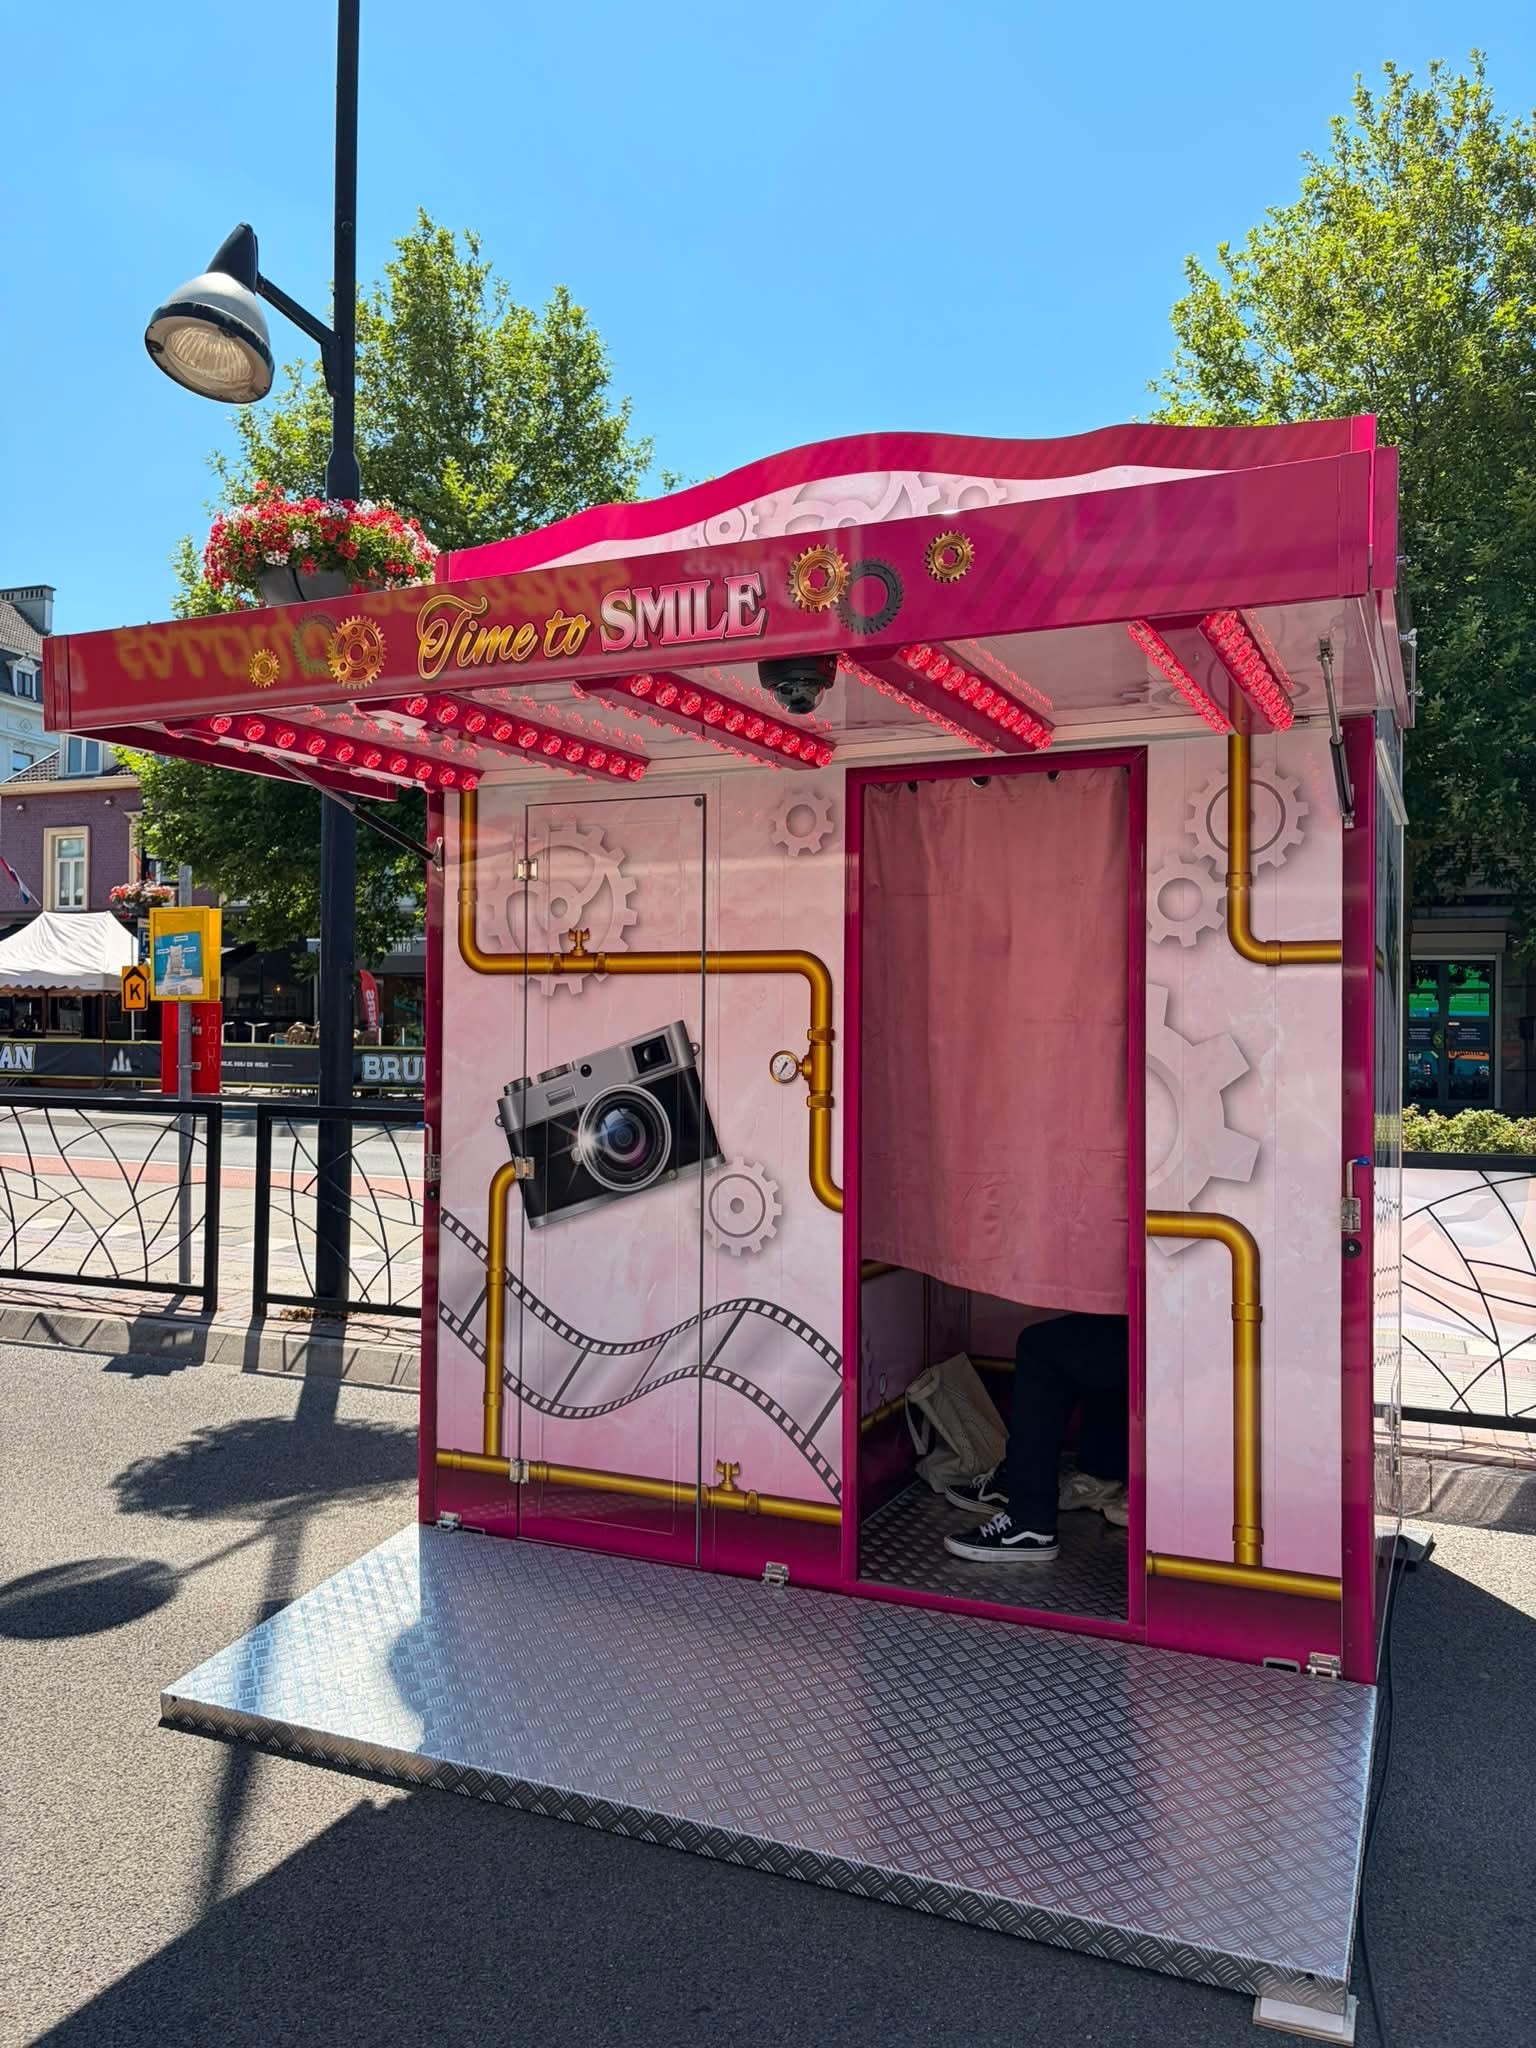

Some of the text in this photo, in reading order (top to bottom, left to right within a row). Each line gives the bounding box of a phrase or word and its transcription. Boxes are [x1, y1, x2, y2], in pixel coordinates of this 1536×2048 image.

[417, 594, 538, 680] Time
[543, 609, 591, 658] to
[601, 572, 766, 652] SMILE
[130, 983, 142, 1001] K
[362, 1055, 426, 1082] BRU
